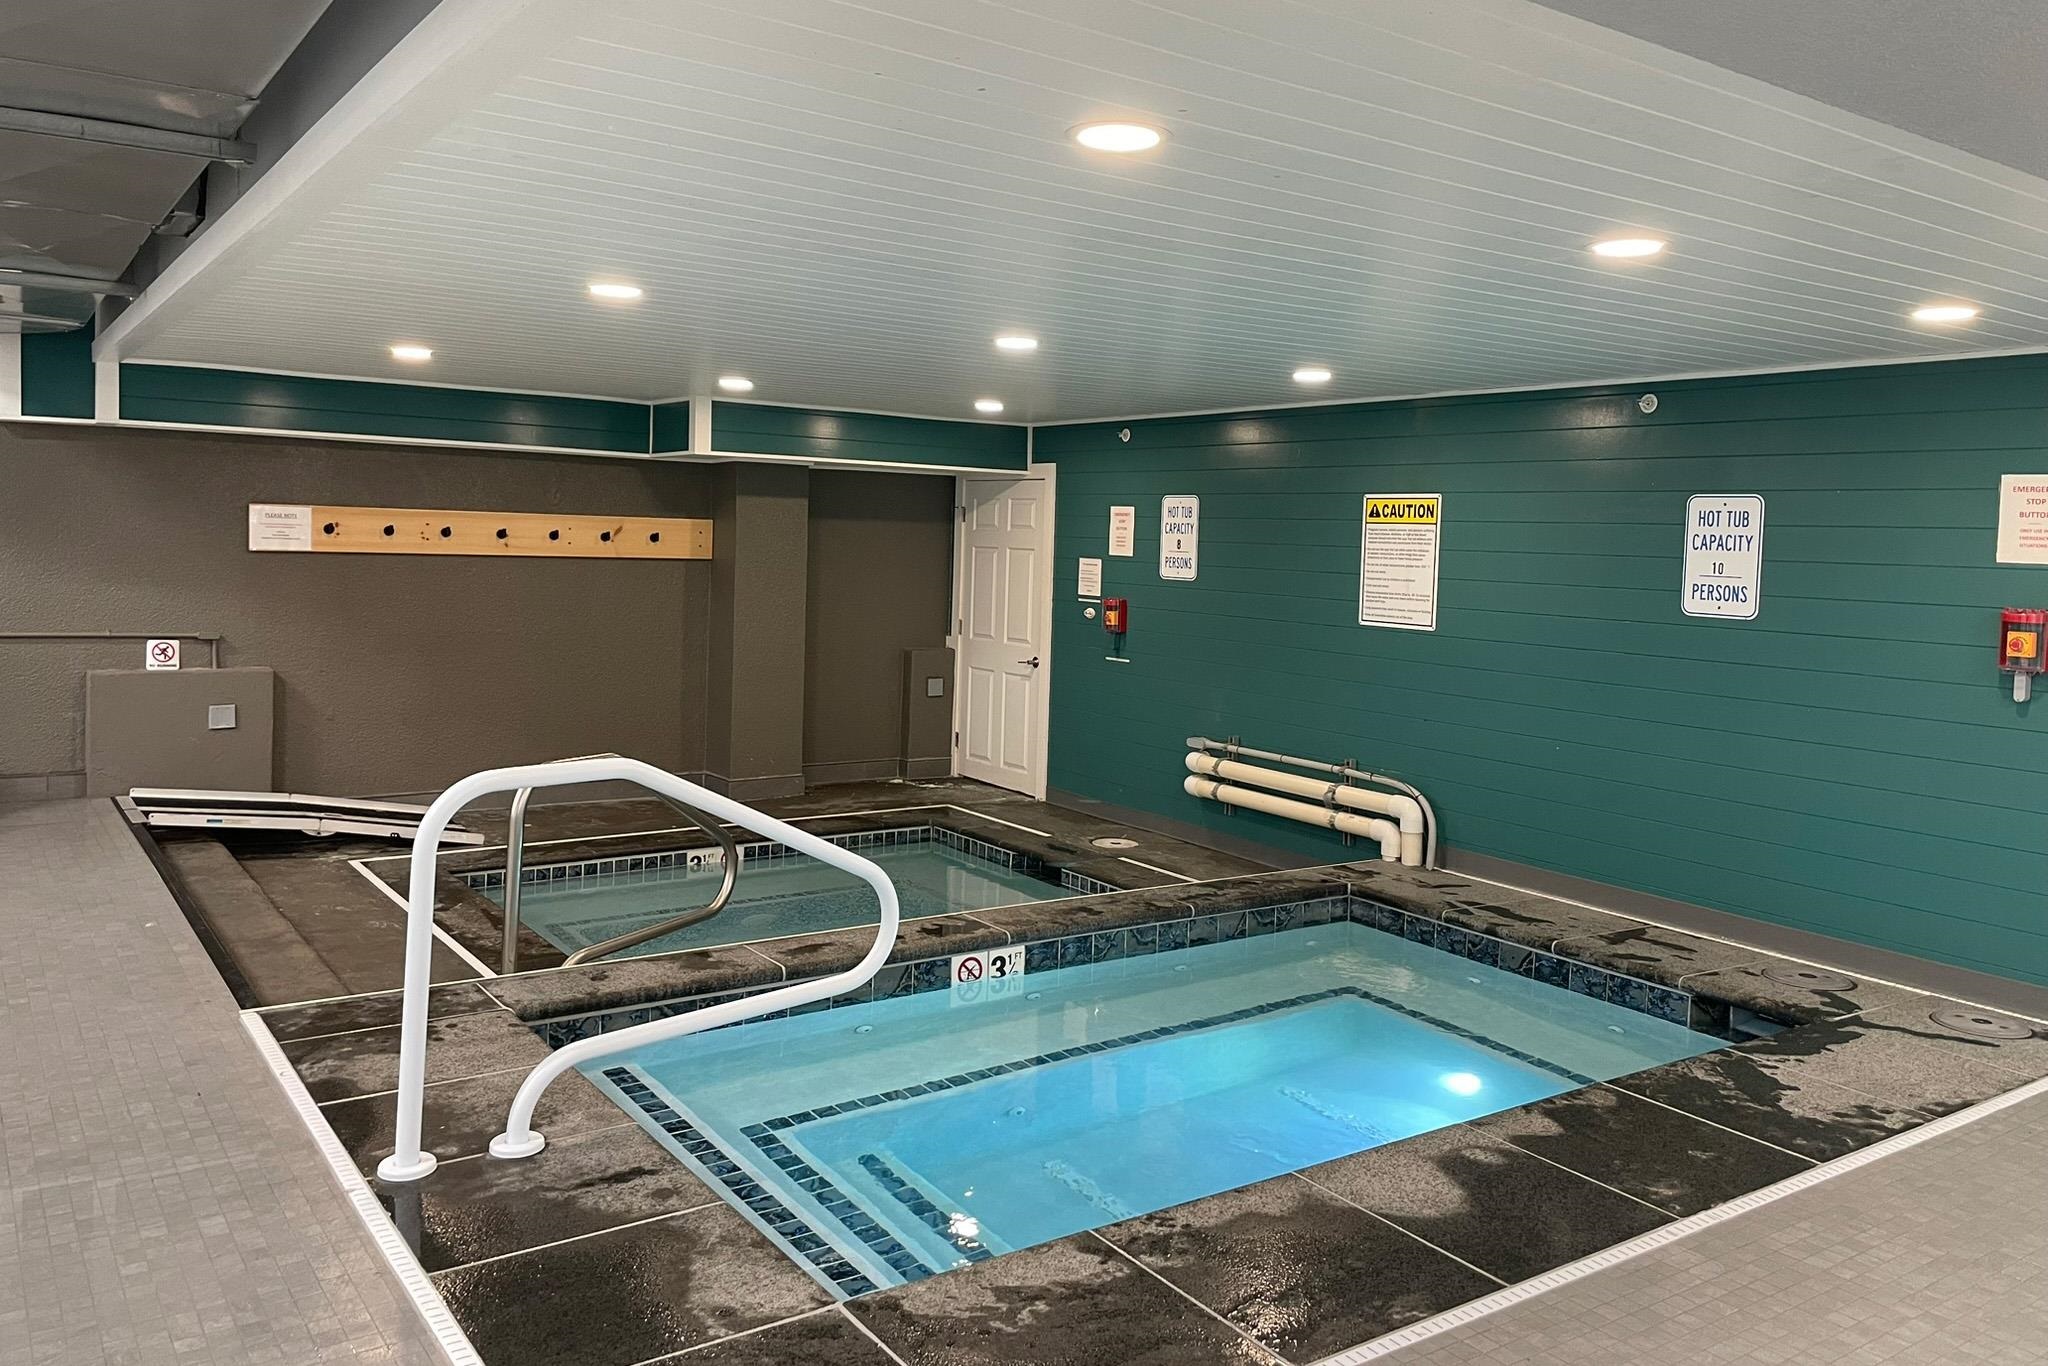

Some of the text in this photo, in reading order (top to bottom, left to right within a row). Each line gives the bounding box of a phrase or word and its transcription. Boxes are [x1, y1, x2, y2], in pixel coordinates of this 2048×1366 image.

[1167, 506, 1193, 519] HOT TUB
[1382, 504, 1434, 519] CAUTION
[1698, 510, 1750, 528] HOT TUB
[1165, 523, 1194, 535] CAPACITY
[1176, 539, 1182, 550] 8
[1692, 533, 1754, 552] CAPACITY
[1165, 556, 1192, 570] PERSONS
[1712, 562, 1724, 575] 10
[1691, 583, 1748, 603] PERSONS
